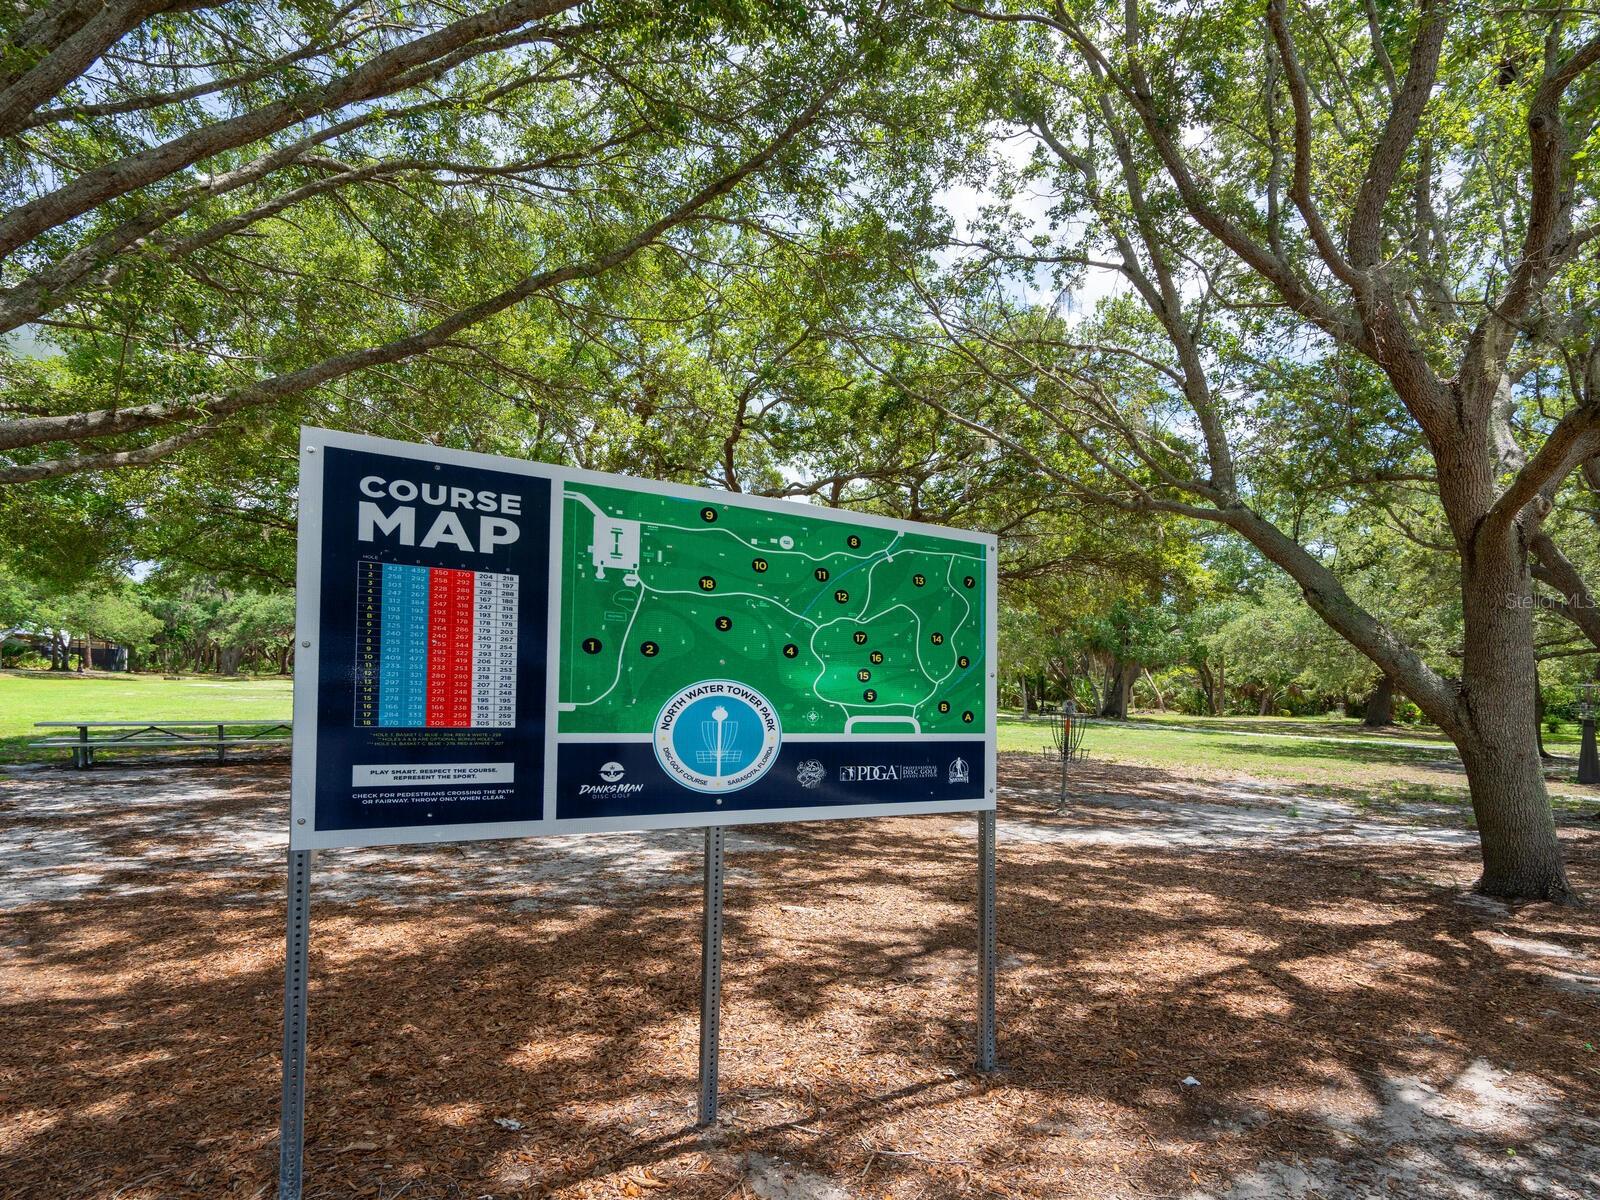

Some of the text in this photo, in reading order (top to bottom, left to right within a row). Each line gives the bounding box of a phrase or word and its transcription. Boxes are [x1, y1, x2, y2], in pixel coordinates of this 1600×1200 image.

[360, 476, 522, 515] COURSE
[706, 511, 714, 519] 9
[358, 501, 520, 554] MAP
[755, 561, 766, 570] 10
[817, 571, 826, 579] 11
[702, 579, 713, 588] 18
[837, 593, 847, 601] 12
[720, 620, 727, 628] 3
[589, 642, 594, 651] 1
[646, 645, 653, 654] 2
[787, 647, 794, 655] 4
[661, 685, 775, 732] NORTH WATER TOWER PARK
[663, 747, 708, 786] DISC GOLF COURSE
[728, 746, 774, 785] SARASOTA, FLORIDA
[857, 765, 898, 780] PDGA
